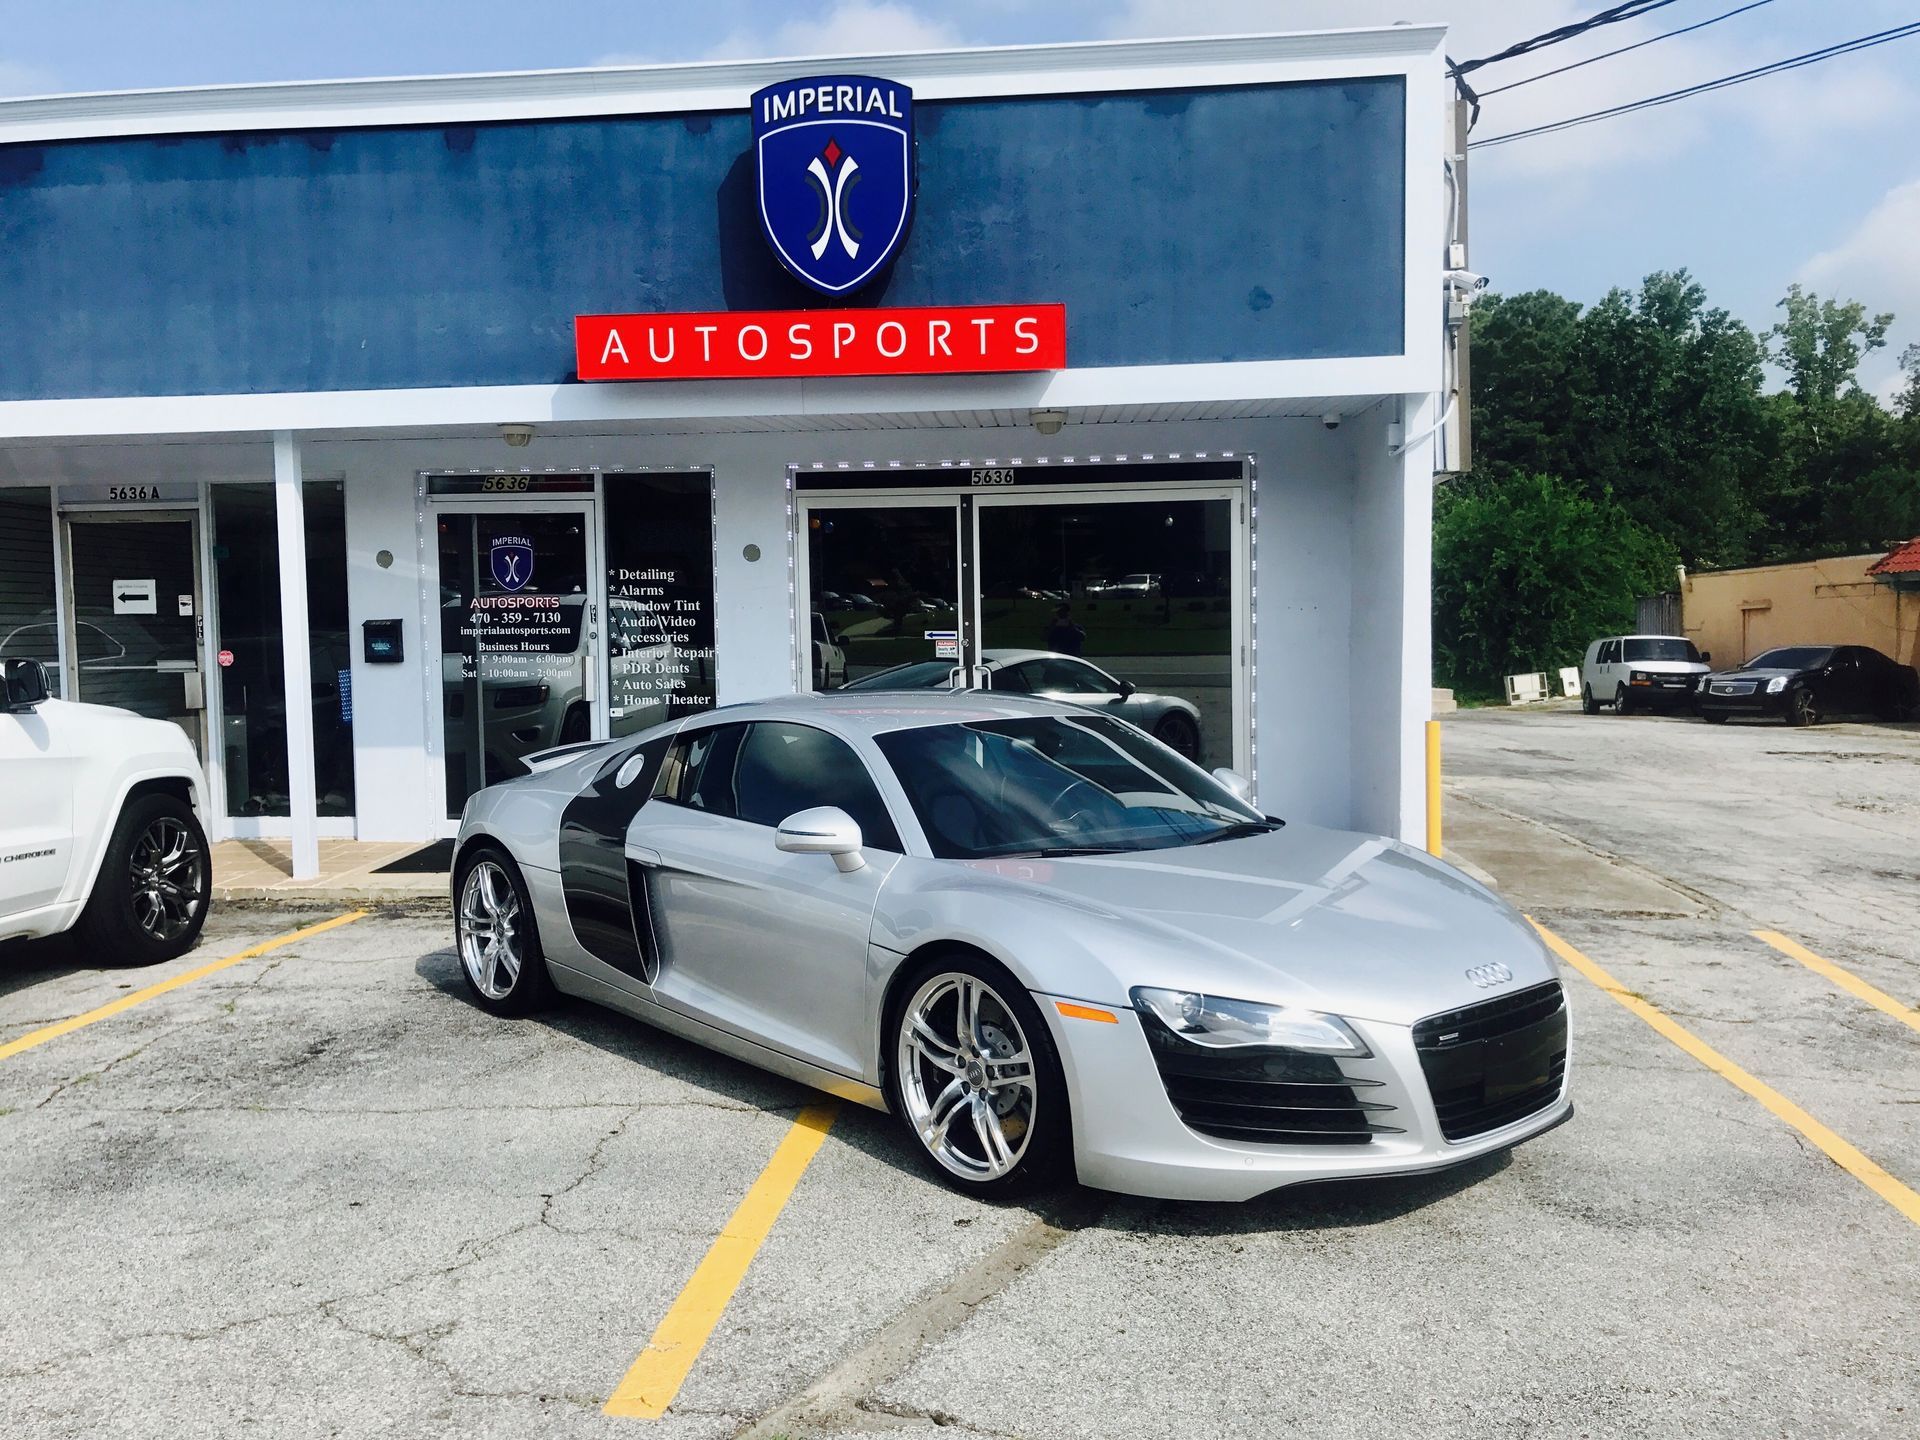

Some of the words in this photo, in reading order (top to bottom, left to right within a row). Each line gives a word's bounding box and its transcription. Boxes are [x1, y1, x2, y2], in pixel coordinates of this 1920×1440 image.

[763, 85, 903, 123] IMPERIAL
[600, 317, 1039, 364] AUTOSPORTS
[484, 476, 528, 490] 5636
[973, 470, 1012, 484] 5636
[492, 536, 532, 547] IMPERIAL
[619, 569, 675, 582] Detailing
[619, 585, 664, 596] Alarms
[470, 597, 560, 609] AUTOSPORTS
[620, 600, 671, 611] Window
[674, 600, 701, 611] Tint
[470, 613, 490, 624] 470
[501, 612, 522, 623] 359
[533, 612, 561, 623] 7130
[460, 626, 571, 637] imperialautosports.com
[622, 631, 689, 643] Accessories
[479, 642, 518, 651] Business
[521, 642, 550, 651] Hours
[622, 647, 669, 658] Interior
[673, 647, 715, 660] Repair
[462, 655, 472, 664] M
[481, 655, 488, 664] F
[492, 655, 527, 664] 9:00am
[536, 655, 571, 666] 6:00pm
[461, 669, 477, 678] Sat
[489, 669, 528, 678] 10:00am
[537, 669, 572, 680] 2:00pm
[622, 663, 652, 674] PDR
[655, 663, 690, 674] Dents
[622, 679, 652, 690] Auto
[655, 678, 686, 690] Sales
[623, 694, 660, 706] Home
[663, 694, 711, 705] Theater
[4, 849, 56, 863] CHEROKEE
